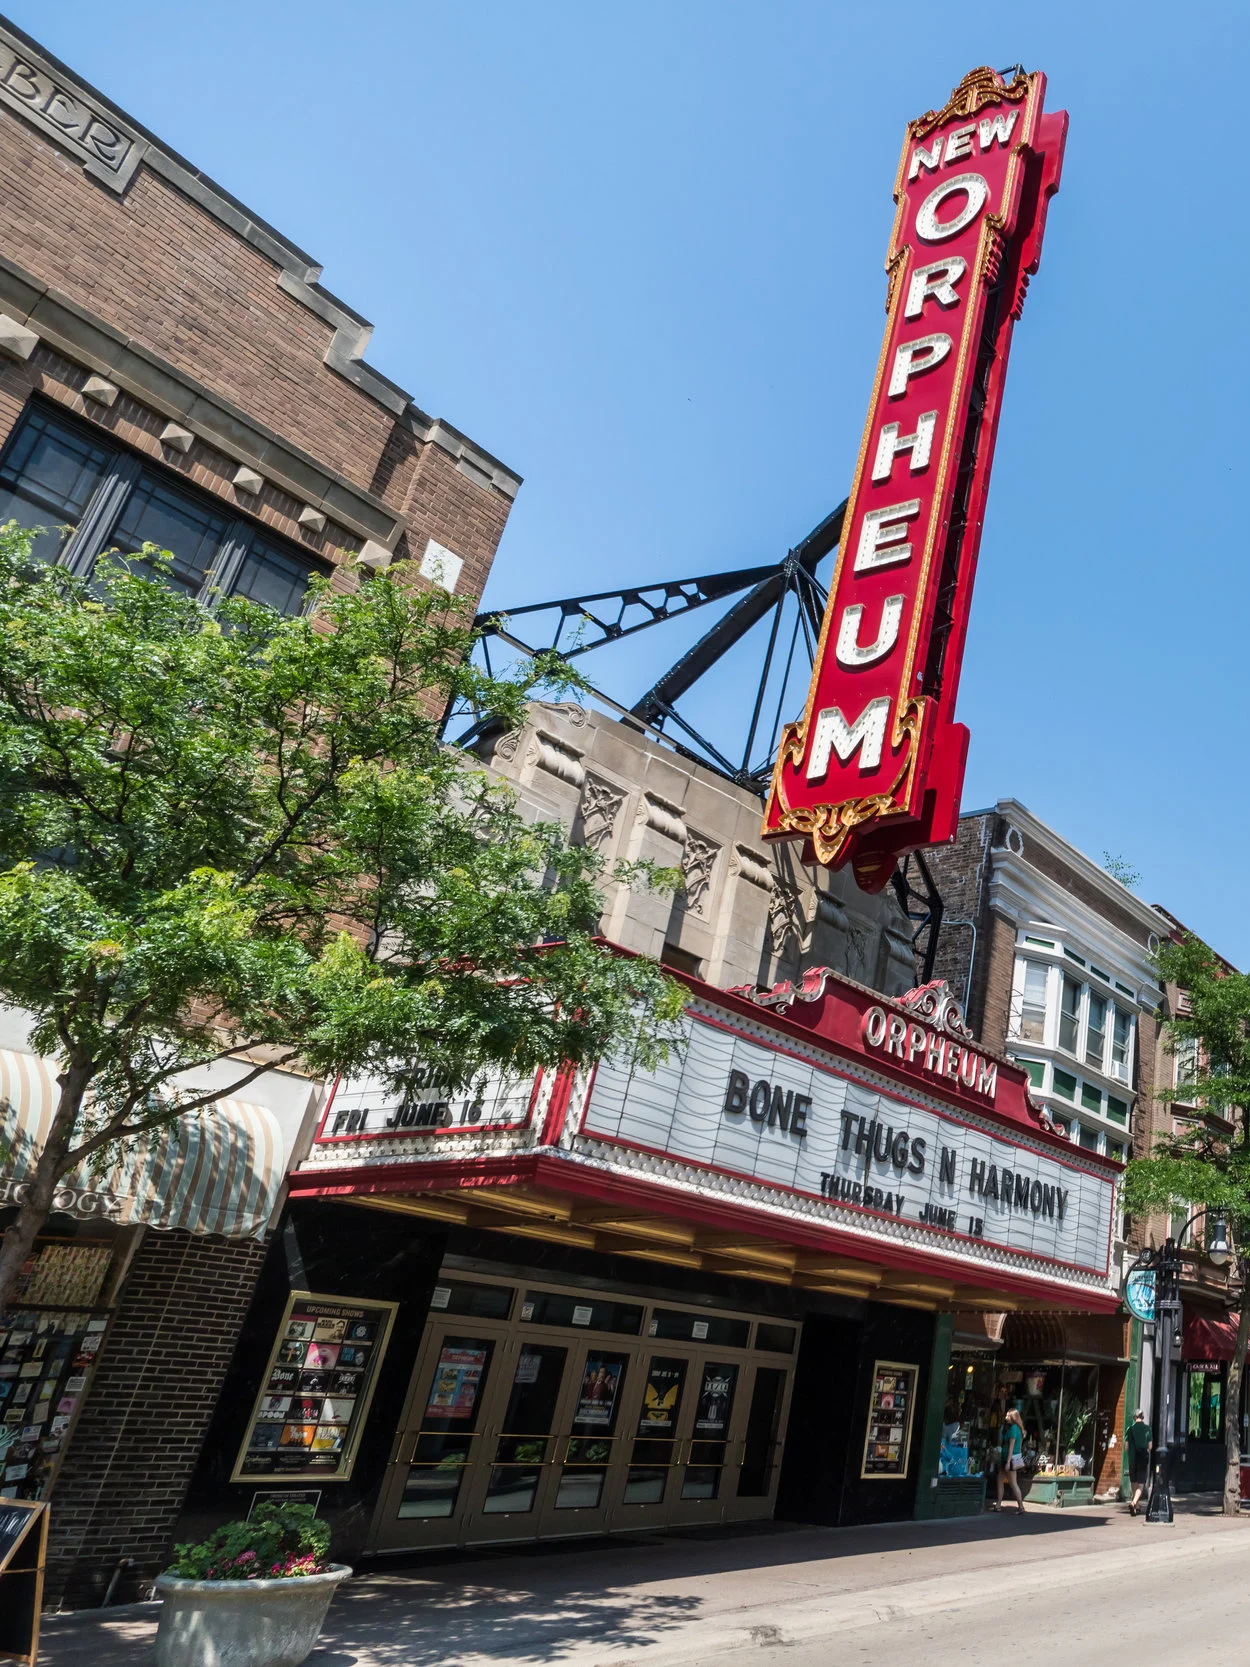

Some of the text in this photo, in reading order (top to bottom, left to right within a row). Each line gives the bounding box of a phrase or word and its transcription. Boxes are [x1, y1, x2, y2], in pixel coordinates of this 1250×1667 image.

[907, 110, 1019, 181] NEW
[806, 172, 987, 780] ORPHEUM
[862, 1006, 997, 1098] ORPHEUM
[331, 1099, 484, 1133] FRI JUNE 16
[724, 1069, 1068, 1220] BONE THUGS N HARMONY
[820, 1172, 983, 1239] THURSDAY JUNE 15
[306, 1305, 364, 1318] UPCOMING SHOWS
